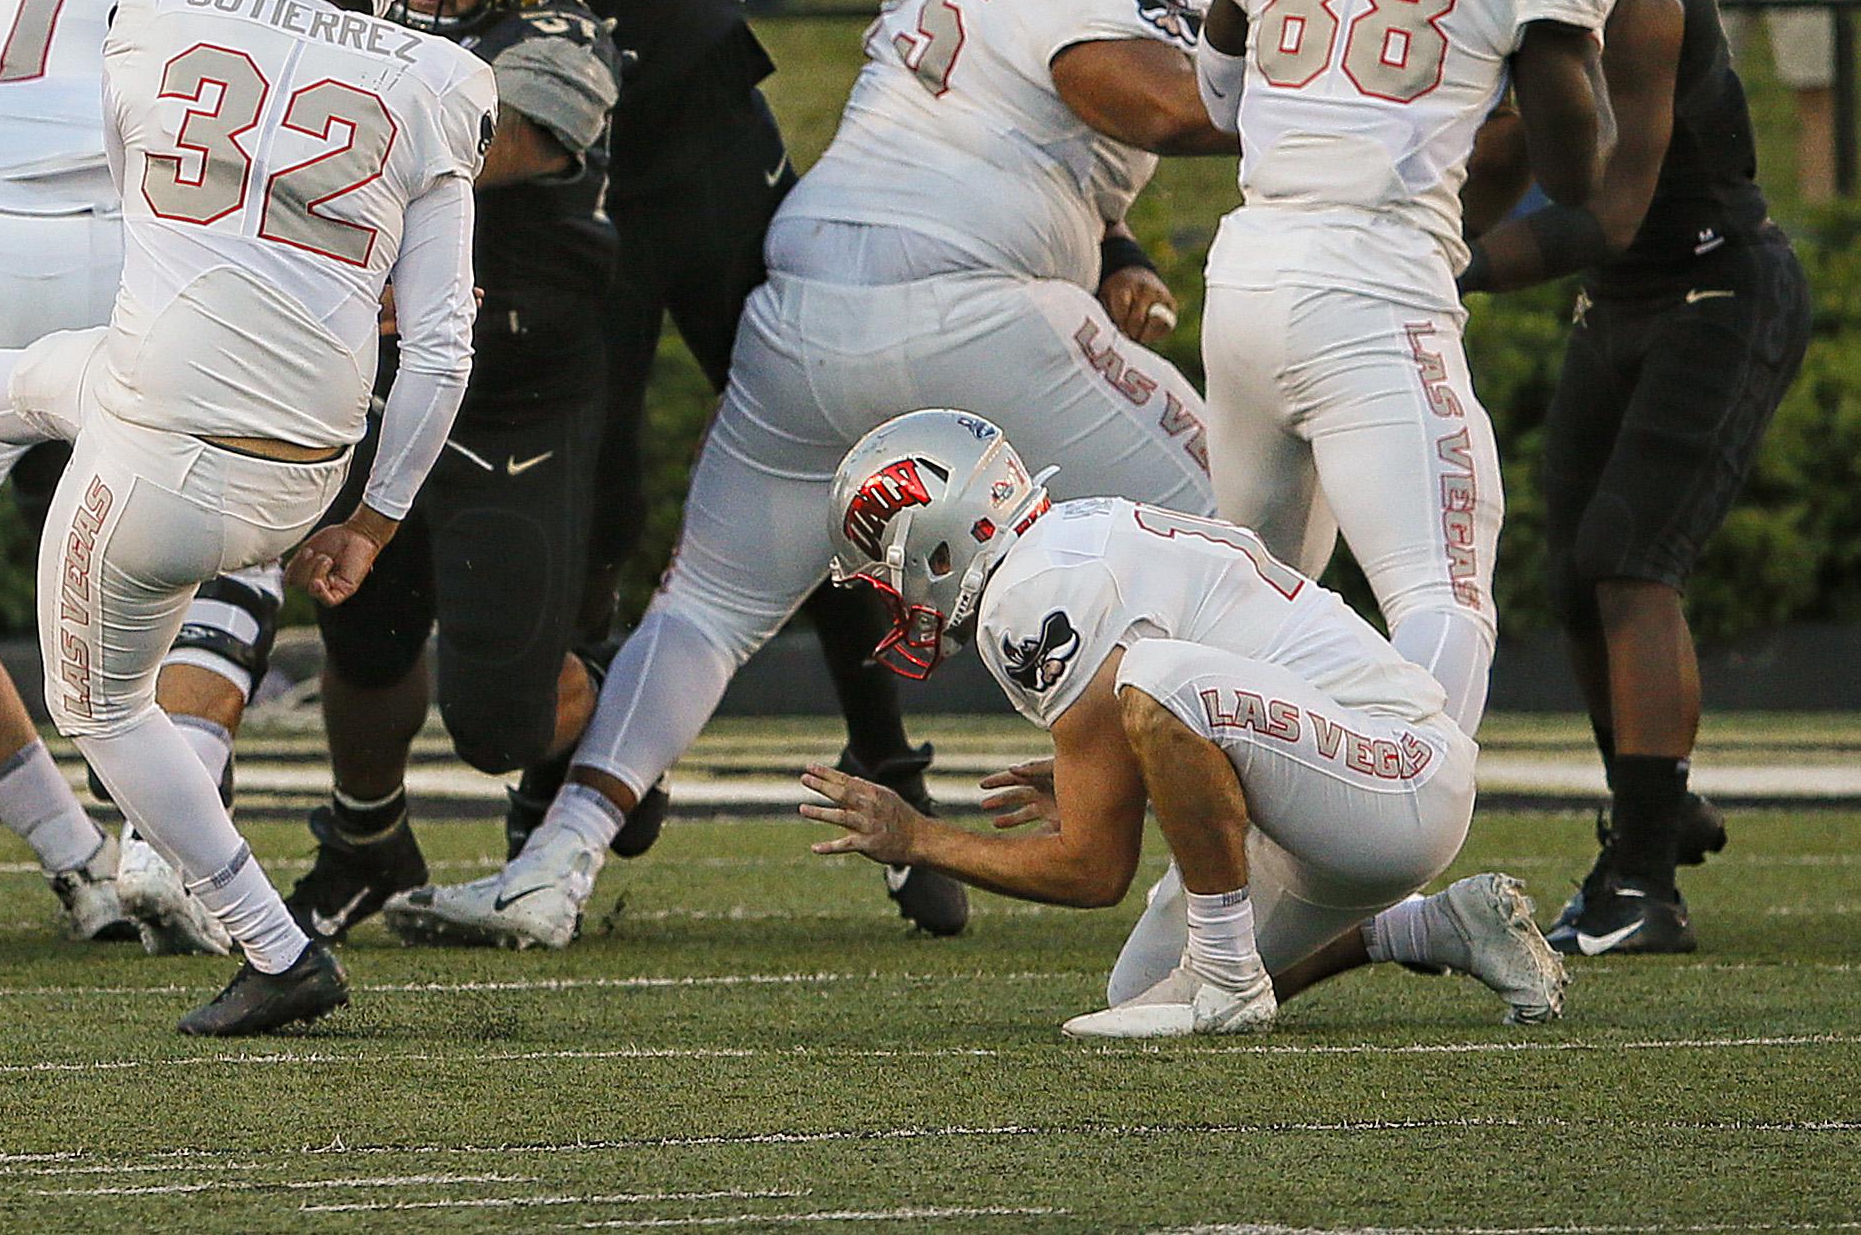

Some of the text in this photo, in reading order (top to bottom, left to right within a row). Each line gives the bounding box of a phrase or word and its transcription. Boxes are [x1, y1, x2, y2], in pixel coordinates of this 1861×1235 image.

[142, 42, 398, 268] 32
[1073, 315, 1158, 407] LAS
[843, 458, 932, 562] UNLV
[1404, 320, 1482, 612] LAS VEGAS
[60, 473, 115, 718] LAS VEGAS
[1200, 688, 1303, 744] LAS
